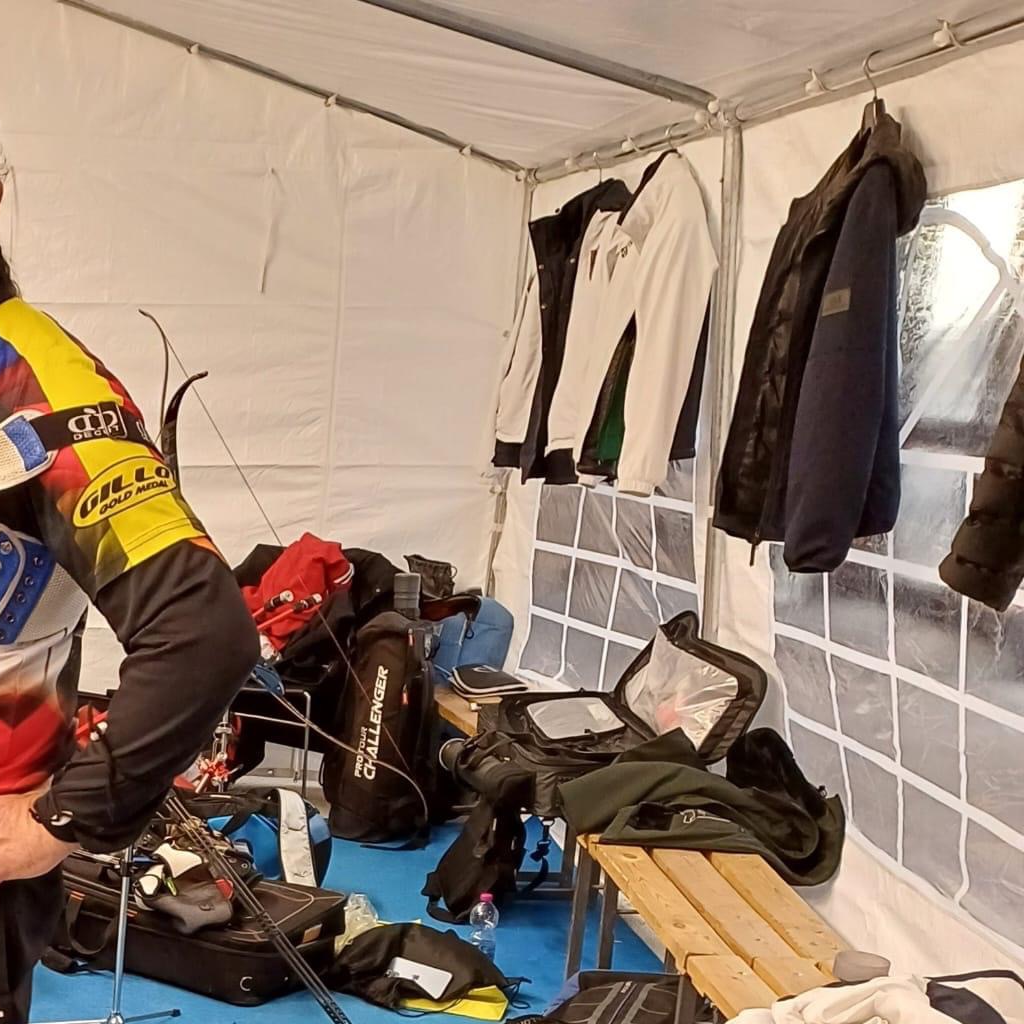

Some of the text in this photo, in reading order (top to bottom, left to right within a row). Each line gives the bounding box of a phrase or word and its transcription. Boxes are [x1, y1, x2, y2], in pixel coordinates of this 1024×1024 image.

[79, 466, 171, 519] GILLO
[99, 480, 169, 515] GOLD MEDAL
[363, 665, 389, 780] CHALLENGER
